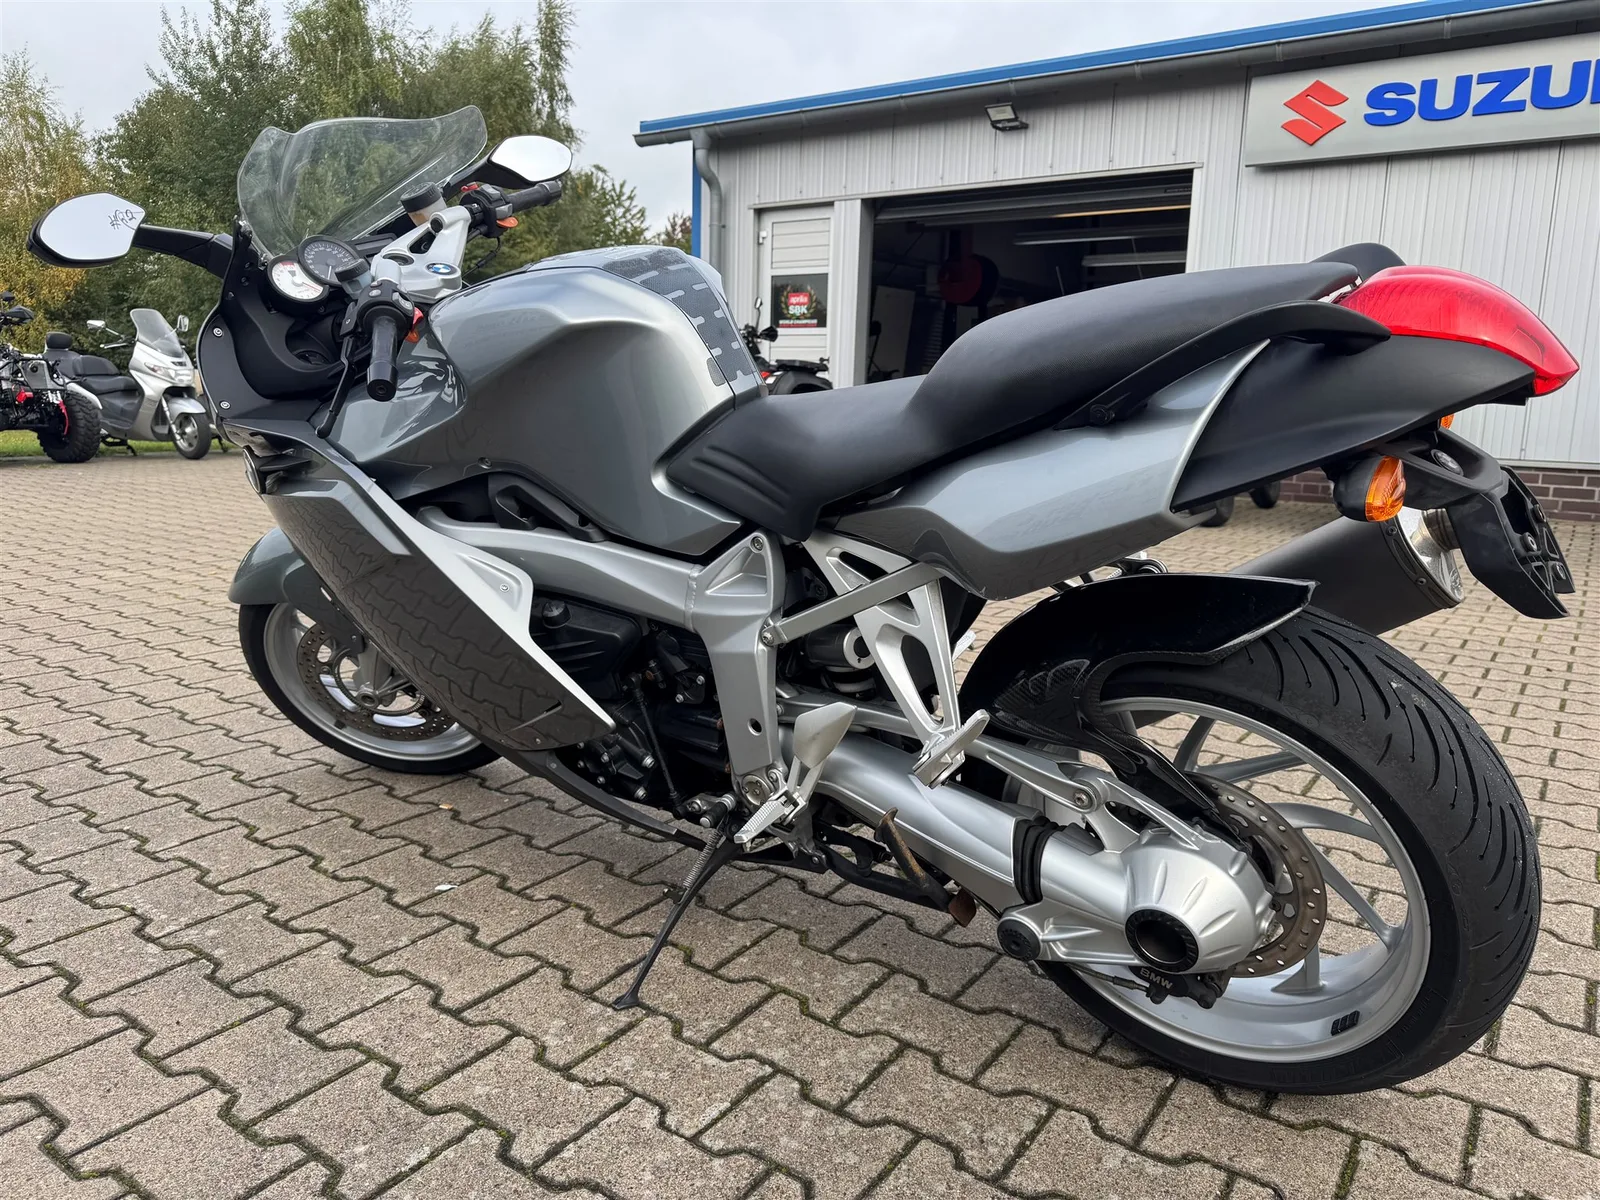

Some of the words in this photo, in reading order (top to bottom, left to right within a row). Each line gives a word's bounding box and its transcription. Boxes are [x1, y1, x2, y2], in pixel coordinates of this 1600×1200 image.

[1364, 58, 1600, 126] SUZU
[788, 304, 807, 315] SBK
[1140, 967, 1173, 989] BMW
